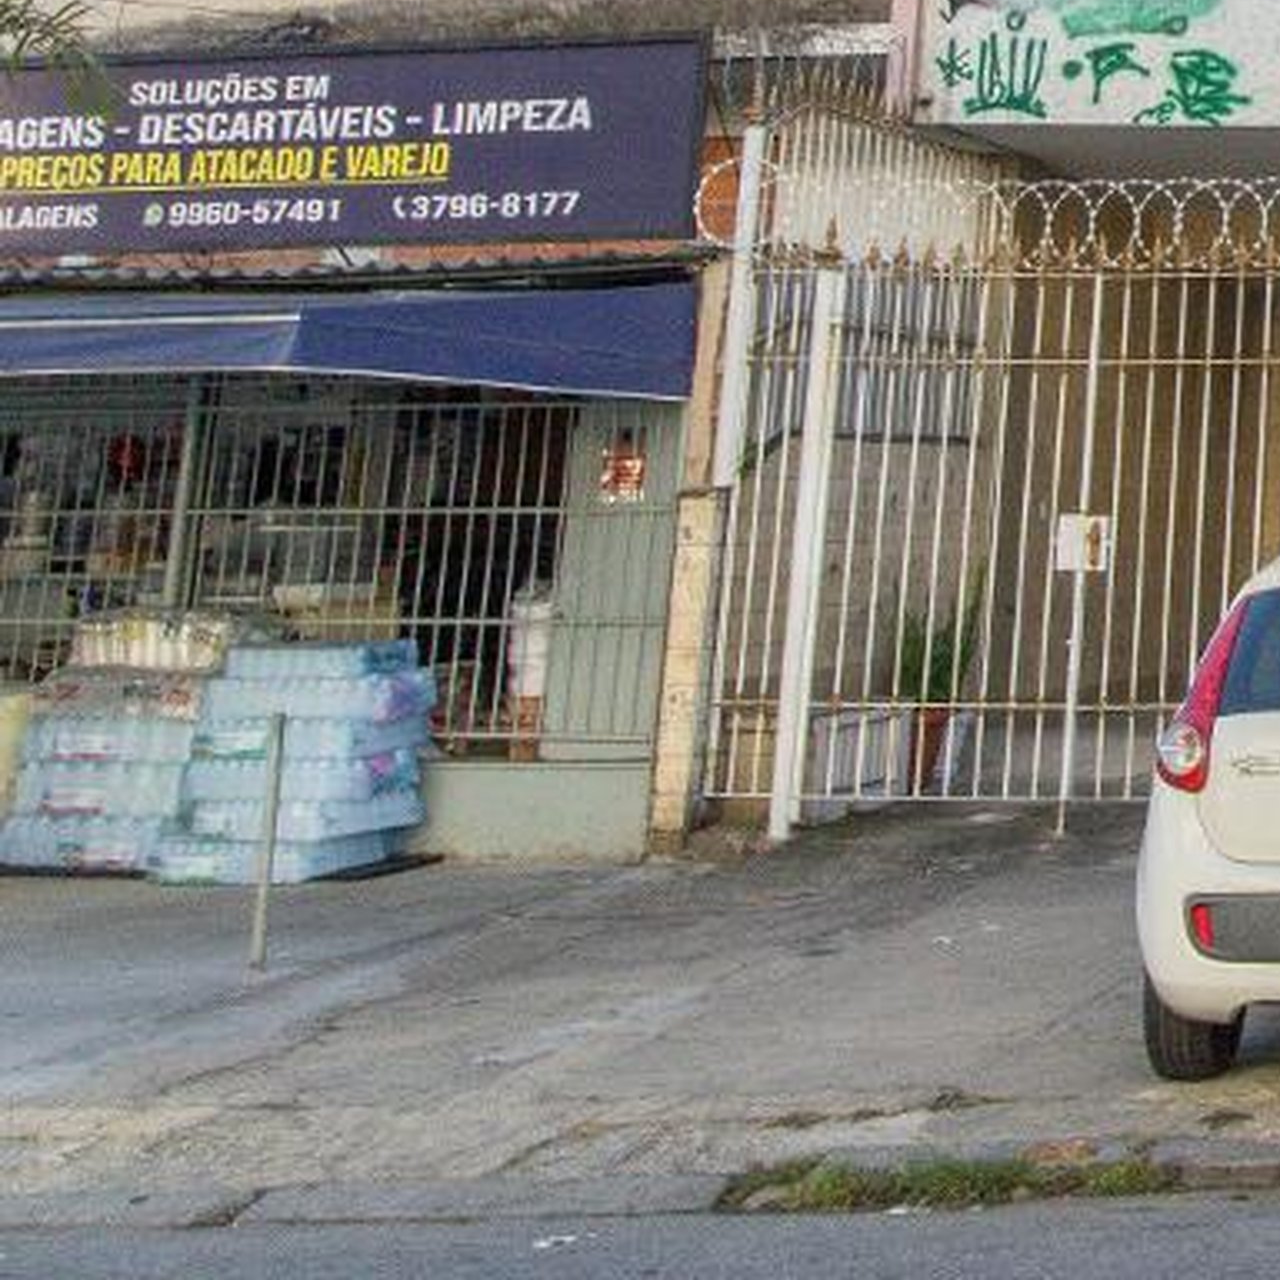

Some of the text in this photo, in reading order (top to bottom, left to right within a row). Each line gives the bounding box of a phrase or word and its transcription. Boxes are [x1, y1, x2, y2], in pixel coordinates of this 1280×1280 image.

[129, 72, 331, 107] SOLUÇÕES EM
[138, 103, 397, 146] DESCARTÁVEIS
[432, 97, 593, 136] LIMPEZA
[0, 141, 451, 192] PREÇOS PARA ATACADO E VAREJO
[0, 203, 99, 231] LAGENS
[411, 190, 582, 221] 3796-8177
